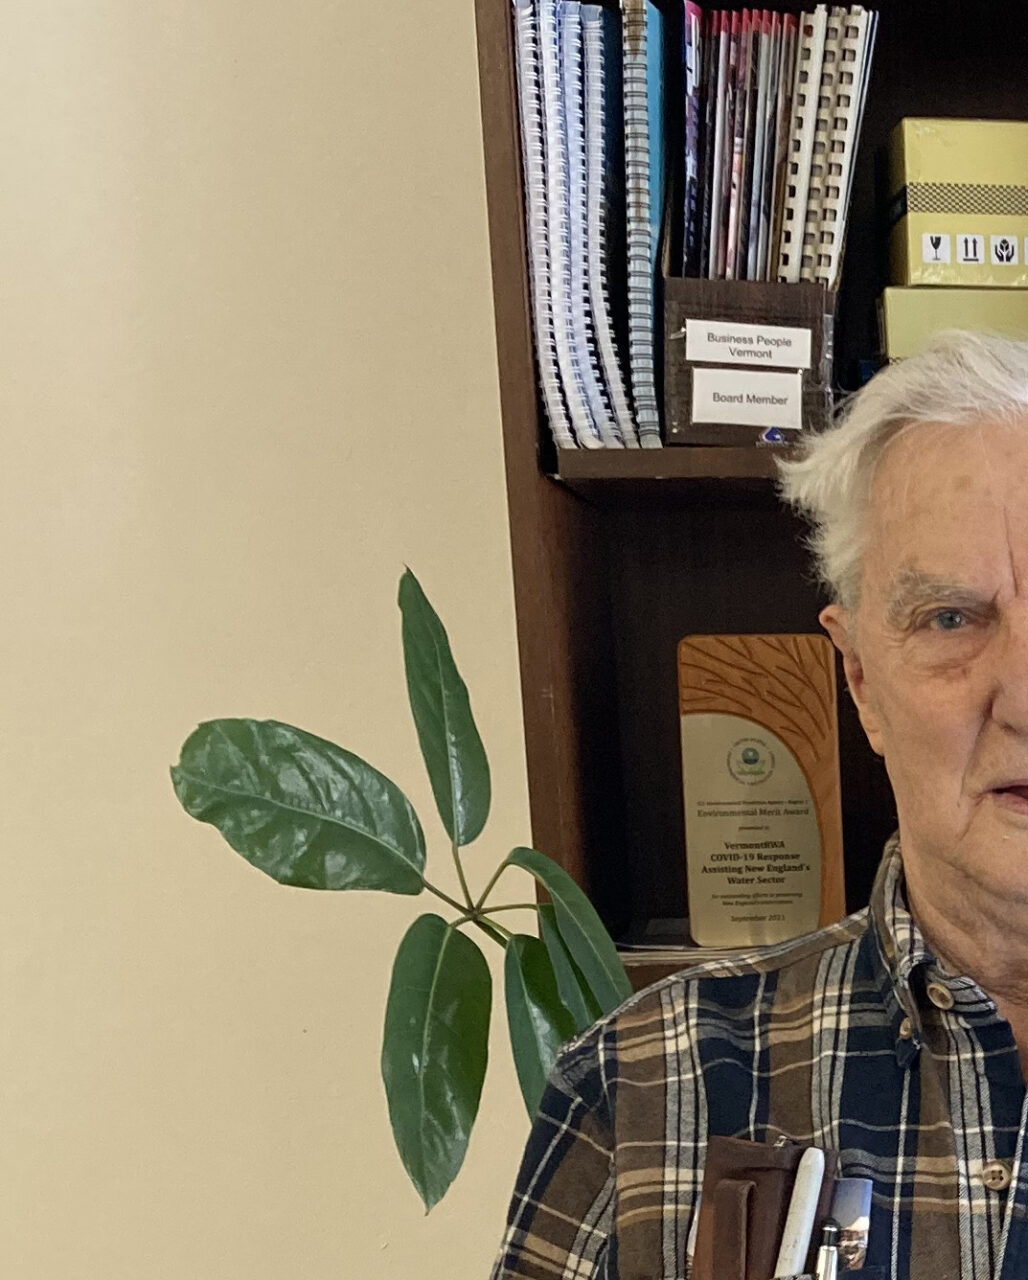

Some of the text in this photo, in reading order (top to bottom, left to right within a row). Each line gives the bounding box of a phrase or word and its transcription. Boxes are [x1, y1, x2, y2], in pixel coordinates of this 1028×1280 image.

[707, 332, 792, 349] Business People
[729, 347, 773, 360] Vermont
[712, 392, 788, 406] Board Member
[697, 807, 809, 817] Environmental Merit Award
[724, 841, 785, 850] VermontRWA
[710, 853, 801, 863] COVID-19 Response
[701, 864, 811, 874] Assisting New England's
[727, 876, 786, 885] Water Sector
